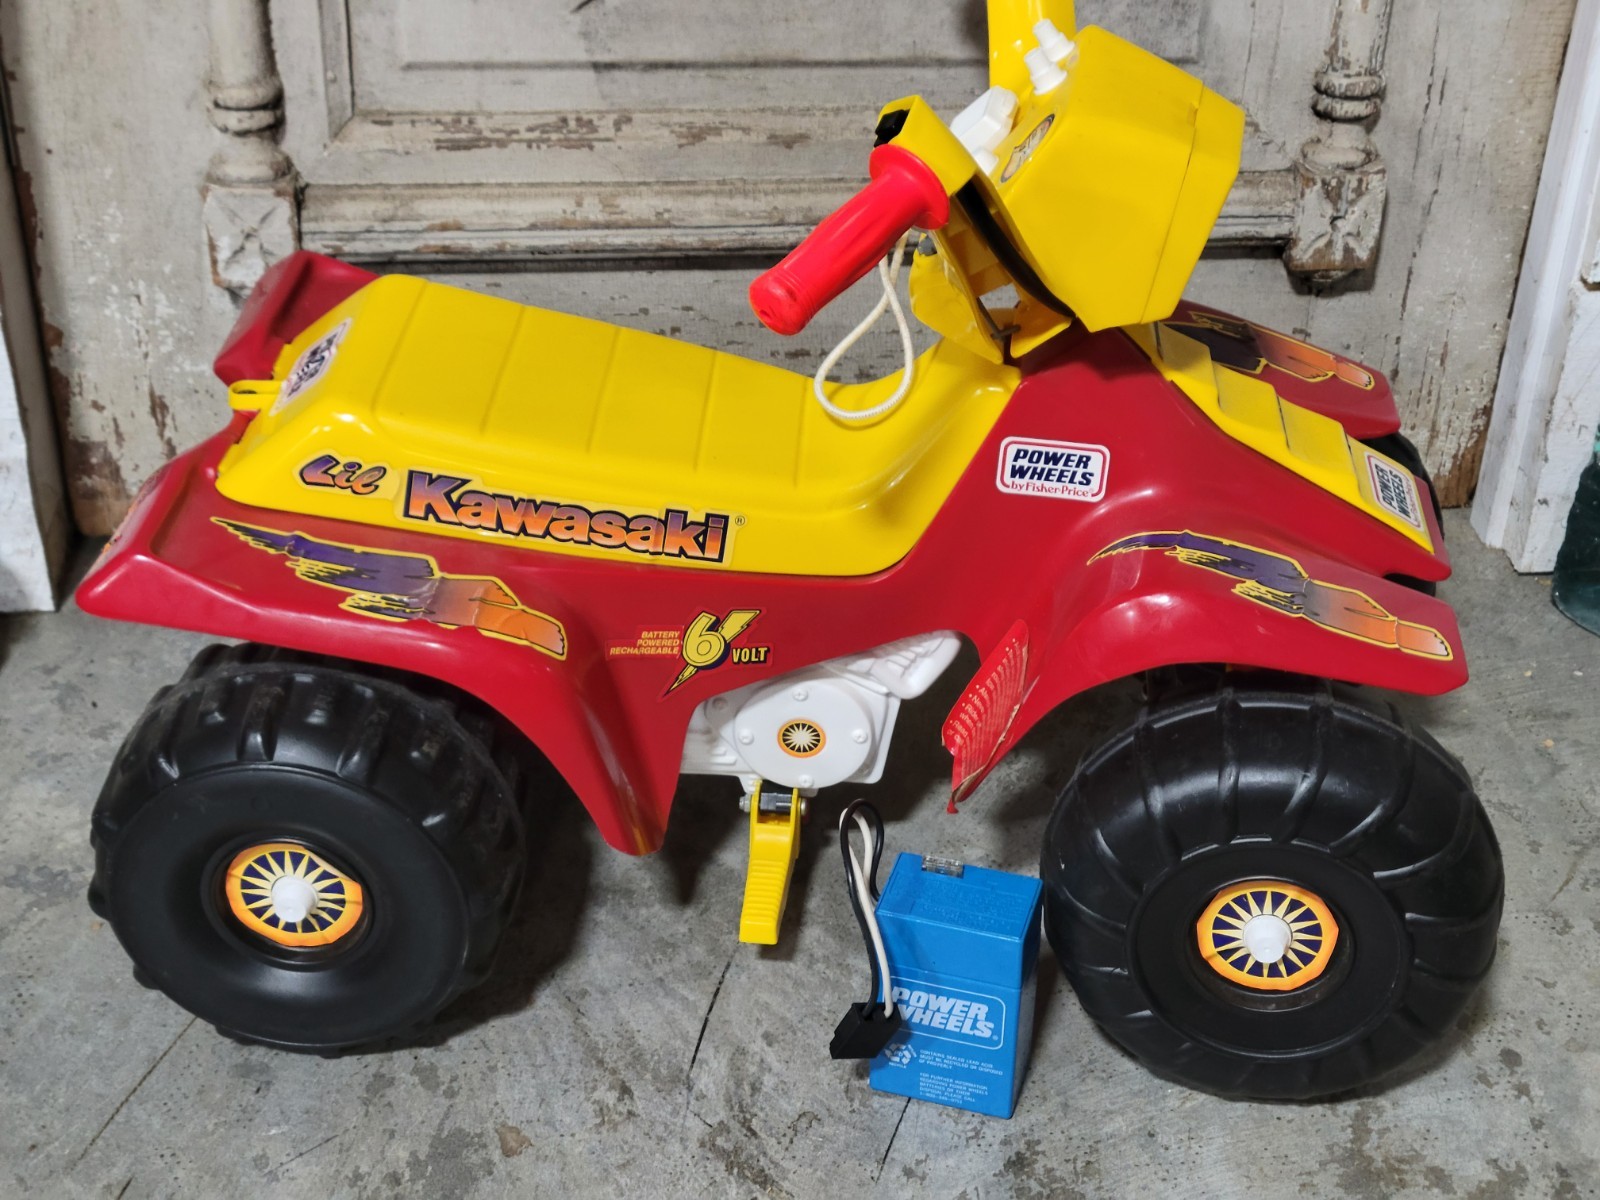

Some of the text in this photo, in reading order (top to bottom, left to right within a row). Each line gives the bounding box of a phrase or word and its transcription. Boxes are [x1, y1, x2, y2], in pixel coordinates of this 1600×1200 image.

[1012, 448, 1092, 469] POWER
[1009, 464, 1095, 487] WHEELS
[1010, 481, 1025, 491] by
[1374, 463, 1397, 510] POWER
[1389, 469, 1412, 519] WHEELS
[299, 454, 730, 564] Lil Kawasaki
[636, 638, 680, 647] POWERED
[641, 630, 680, 639] BATTERY
[682, 610, 771, 670] 6 VOLT
[609, 646, 680, 655] RECHARGEABLE
[892, 986, 989, 1021] POWER
